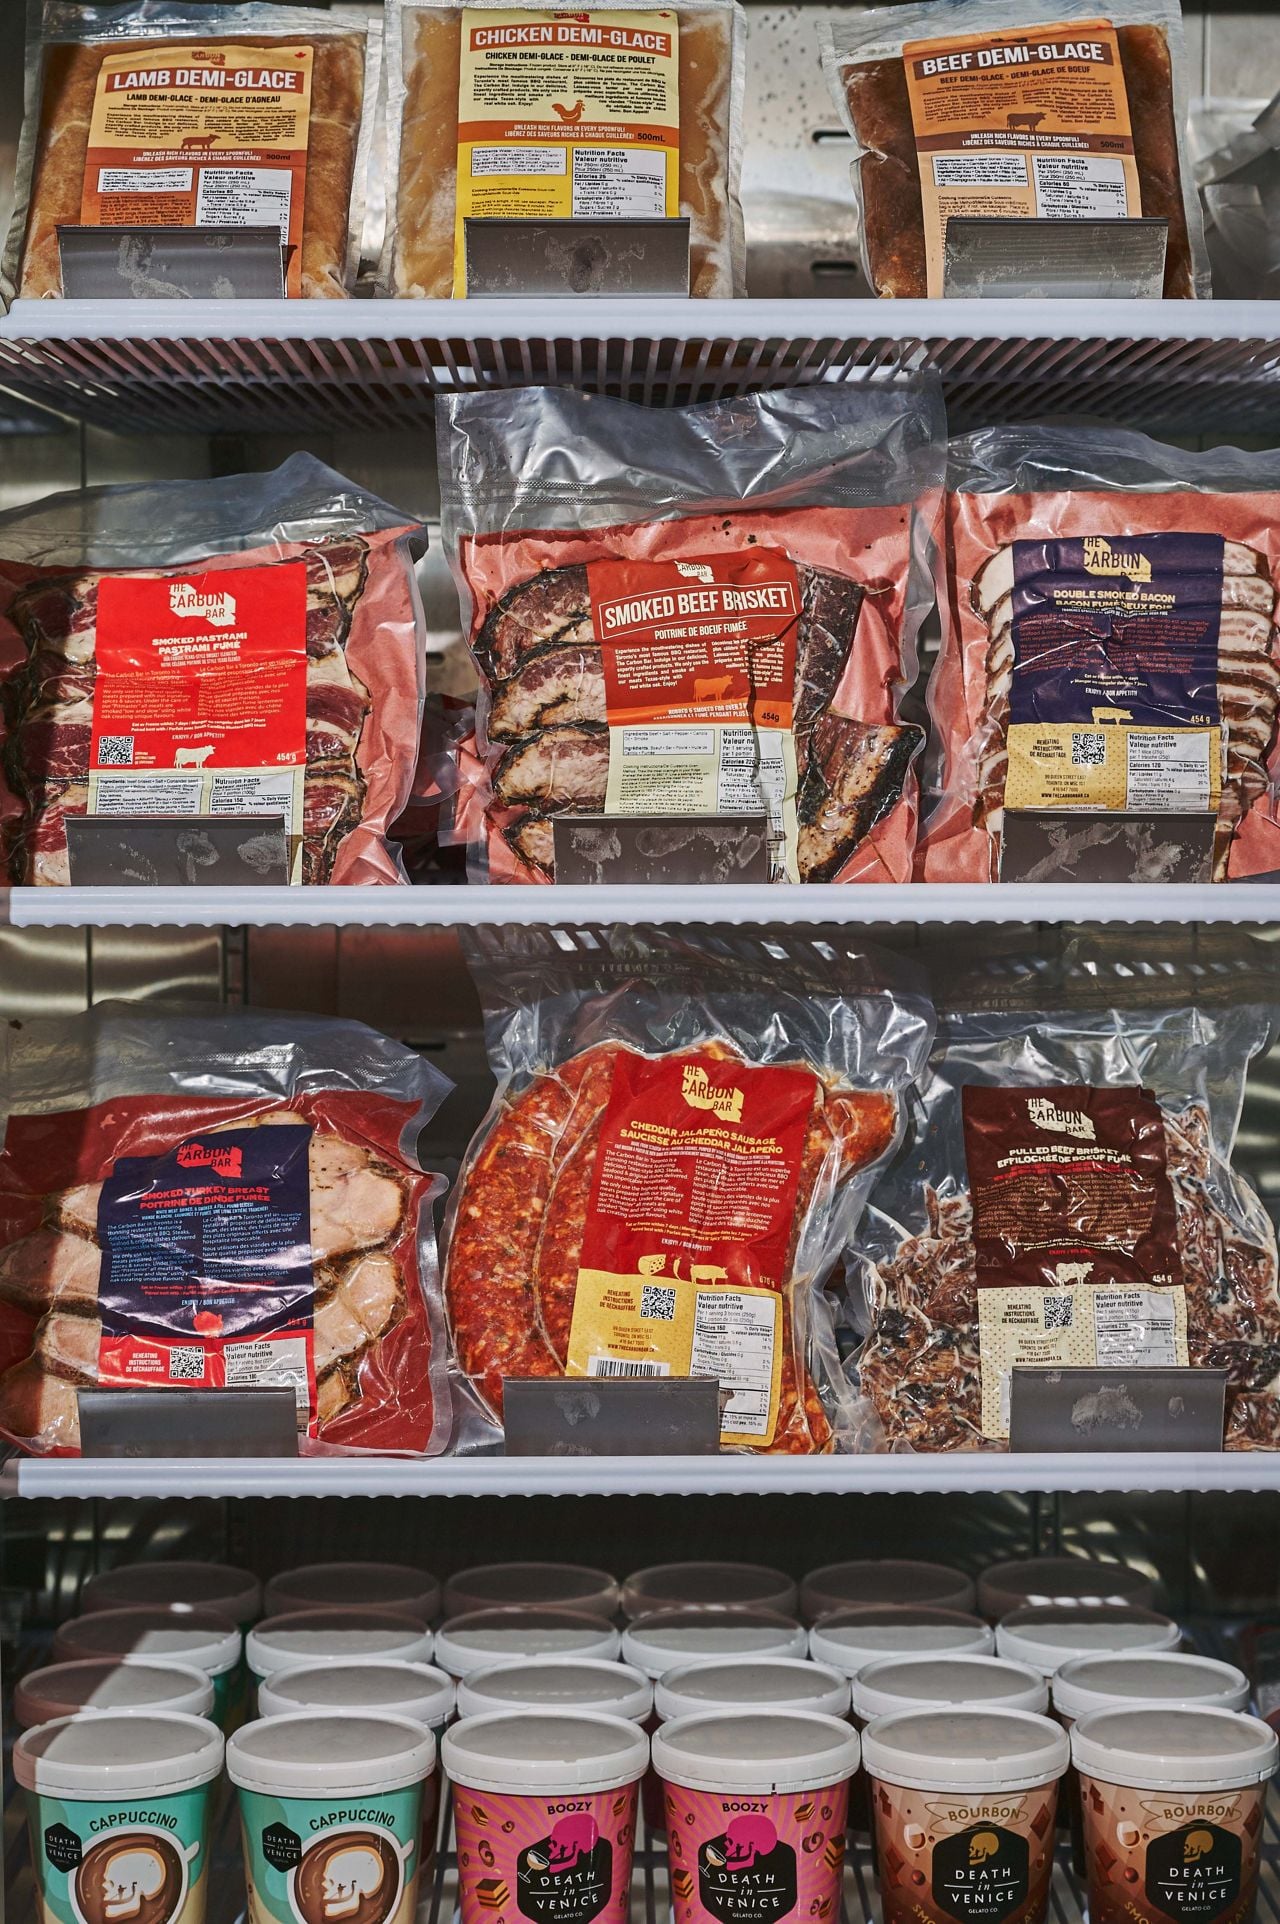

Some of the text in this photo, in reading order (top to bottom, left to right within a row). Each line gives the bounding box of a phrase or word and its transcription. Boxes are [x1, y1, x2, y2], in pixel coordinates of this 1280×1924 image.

[475, 26, 667, 52] CHICKEN DEMI-GLACE
[485, 52, 518, 60] CHICKEN
[519, 52, 564, 61] DEMI-GLACE
[570, 54, 616, 62] DEMI-GLACE
[628, 56, 656, 64] POULET
[922, 42, 1105, 75] BEEF DEMI-GLACE
[113, 69, 297, 90] LAMB DEMI-GLACE
[939, 76, 958, 84] BEEF
[959, 73, 1004, 83] DEMI-GLACE
[1010, 68, 1055, 80] DEMI-GLACE
[126, 93, 281, 104] LAMB DEMI-GLACE DEMI-GLACE D'AGNEAU
[513, 123, 537, 131] UNLEASH
[537, 123, 550, 131] RICH
[551, 123, 573, 132] FLAVORS
[573, 124, 580, 132] IN
[580, 124, 597, 133] EVERY
[637, 132, 666, 142] 500mL
[574, 149, 625, 158] Nutrition Facts
[1081, 537, 1100, 548] THE
[1083, 551, 1140, 569] CARBON
[1053, 590, 1176, 603] DOUBLE SMOKED BACON
[205, 607, 225, 618] BAR
[605, 587, 788, 629] SMOKED BEEF BRISKET
[654, 620, 748, 640] POITRINE DE BOEUF FUMÉE
[152, 632, 247, 646] SMOKED PASTRAMI
[158, 640, 241, 654] PASTRAMI FUMÉ
[761, 711, 780, 722] 454g
[1191, 714, 1210, 724] 454 g
[712, 1100, 733, 1111] BAR
[630, 1120, 777, 1145] CHEDDAR JALAPEÑO SAUSAGE
[1065, 1126, 1086, 1134] BAR
[620, 1129, 670, 1146] SAUCISSE
[671, 1138, 683, 1146] AU
[684, 1137, 731, 1150] CHEDDAR
[731, 1144, 784, 1155] JALAPEÑO
[1009, 1146, 1050, 1157] PULLED
[1051, 1145, 1075, 1154] BEEF
[211, 1158, 232, 1168] BAR
[997, 1154, 1059, 1169] EFFILOCHÉE
[1059, 1155, 1071, 1164] DE
[141, 1186, 270, 1200] SMOKED TURKEY BREAST
[140, 1193, 270, 1209] POITRINE DE DINDE FUMÉE
[1152, 1274, 1172, 1283] 454 g
[607, 1289, 631, 1297] REHEATING
[698, 1293, 742, 1303] Nutrition Facts
[1095, 1292, 1140, 1301] Nutrition Facts
[602, 1295, 634, 1304] INSTRUCTIONS
[1095, 1300, 1144, 1309] Valeur nutritive
[718, 1303, 744, 1311] nutritive
[128, 1358, 161, 1366] INSTRUCTIONS
[125, 1365, 133, 1373] DE
[547, 1801, 593, 1815] BOOZY
[722, 1802, 769, 1813] BOOZY
[1162, 1805, 1235, 1819] BOURBON
[309, 1809, 397, 1831] CAPPUCCINO
[947, 1807, 1020, 1822] BOURBON
[89, 1810, 179, 1832] CAPPUCCINO
[49, 1834, 77, 1846] DEATH
[267, 1834, 296, 1845] DEATH
[48, 1849, 79, 1860] VENICE
[266, 1848, 298, 1860] VENICE
[955, 1867, 1011, 1880] DEATH
[1169, 1865, 1225, 1878] DEATH
[540, 1871, 596, 1887] DEATH
[718, 1873, 775, 1885] DEATH
[1191, 1879, 1204, 1889] in
[563, 1886, 576, 1896] in
[740, 1886, 753, 1896] in
[977, 1881, 990, 1891] in
[951, 1890, 1014, 1904] VENICE
[1164, 1888, 1227, 1901] VENICE
[536, 1893, 599, 1910] VENICE
[715, 1895, 780, 1909] VENICE
